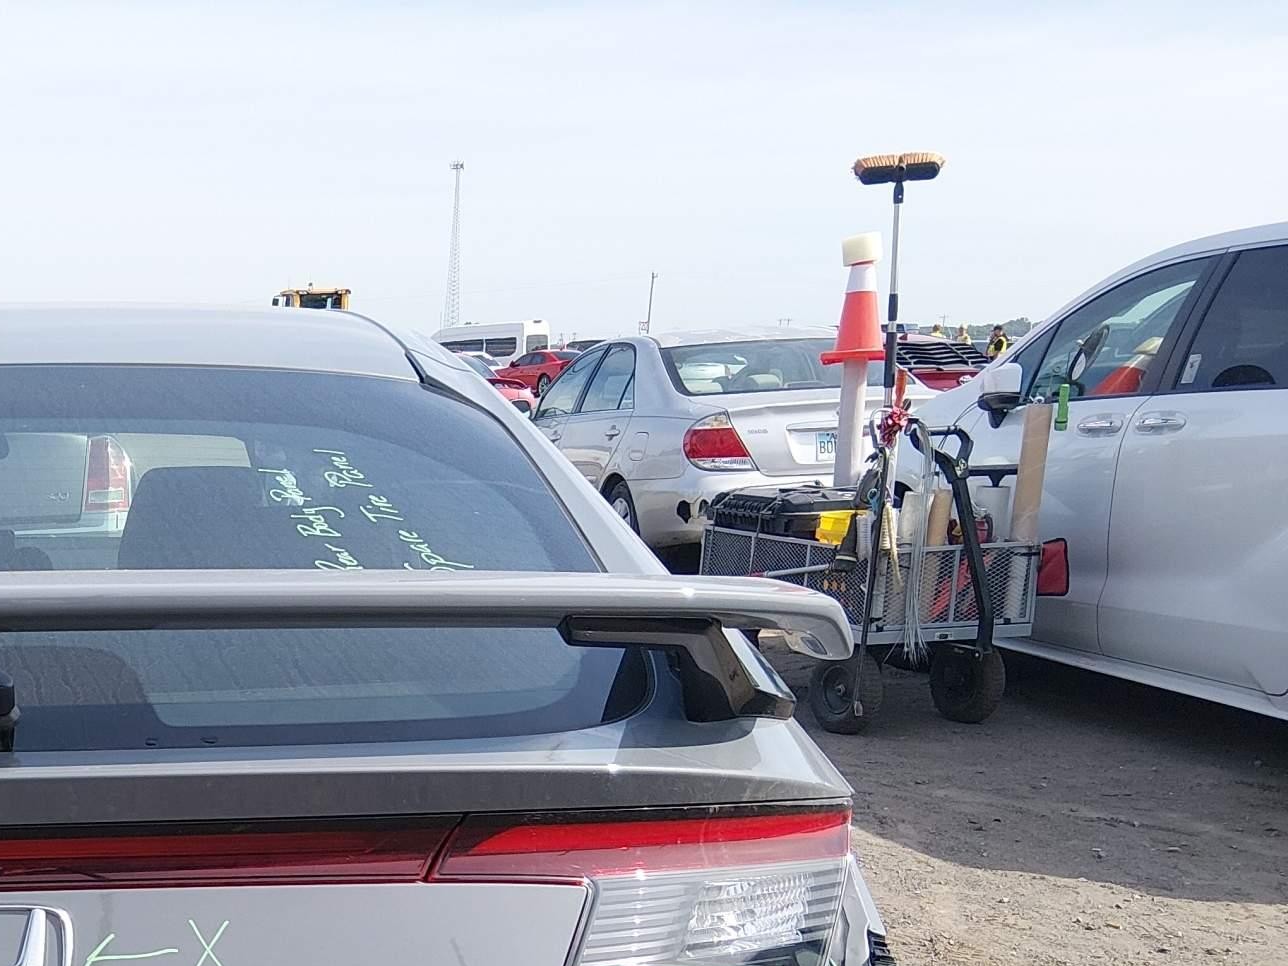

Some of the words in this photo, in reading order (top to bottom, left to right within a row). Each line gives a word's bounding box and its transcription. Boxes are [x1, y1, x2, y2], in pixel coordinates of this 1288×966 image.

[313, 448, 374, 489] Panel
[289, 505, 345, 537] Body
[360, 495, 404, 522] Tire
